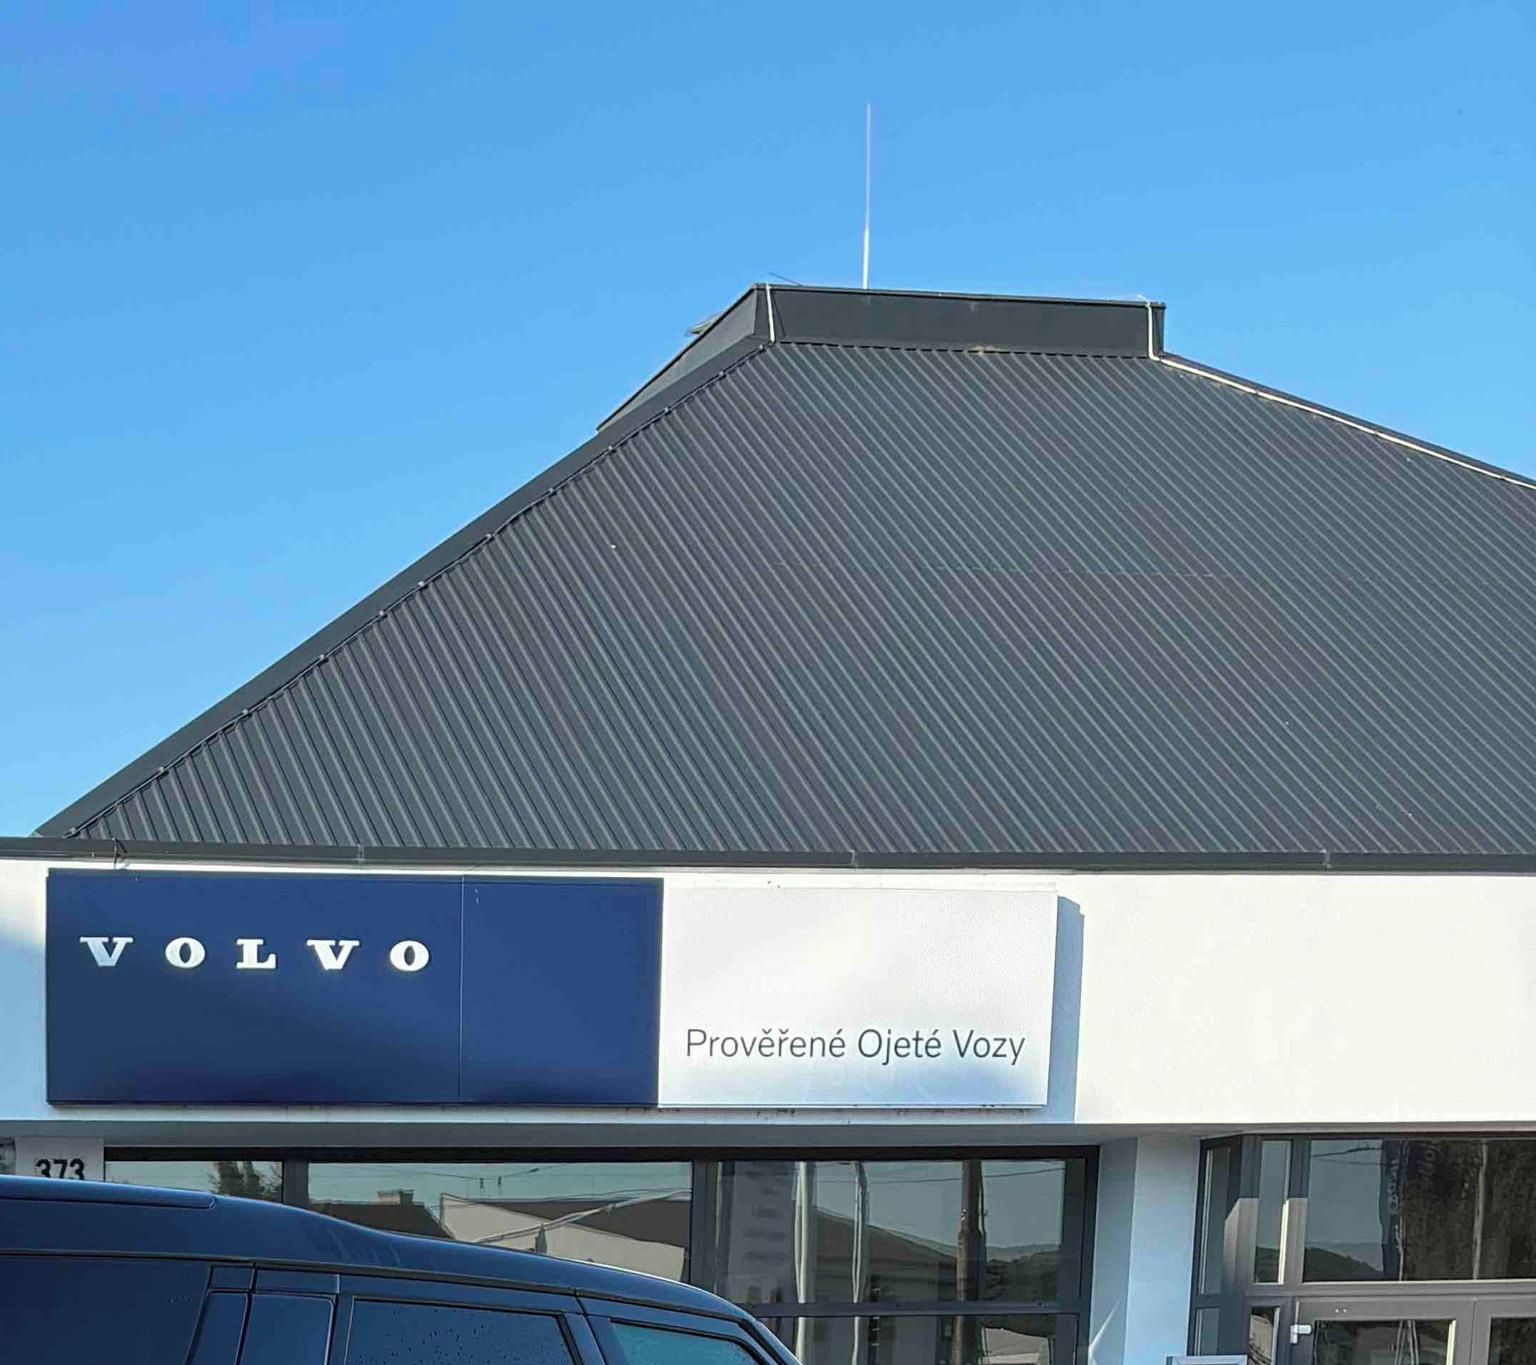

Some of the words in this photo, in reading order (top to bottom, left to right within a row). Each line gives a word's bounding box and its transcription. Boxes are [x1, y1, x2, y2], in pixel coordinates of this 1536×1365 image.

[79, 936, 430, 972] VOLVO
[687, 1027, 846, 1058] Prověřené
[858, 1028, 942, 1066] Ojeté
[953, 1028, 1026, 1066] Vozy
[36, 1158, 84, 1180] 373
